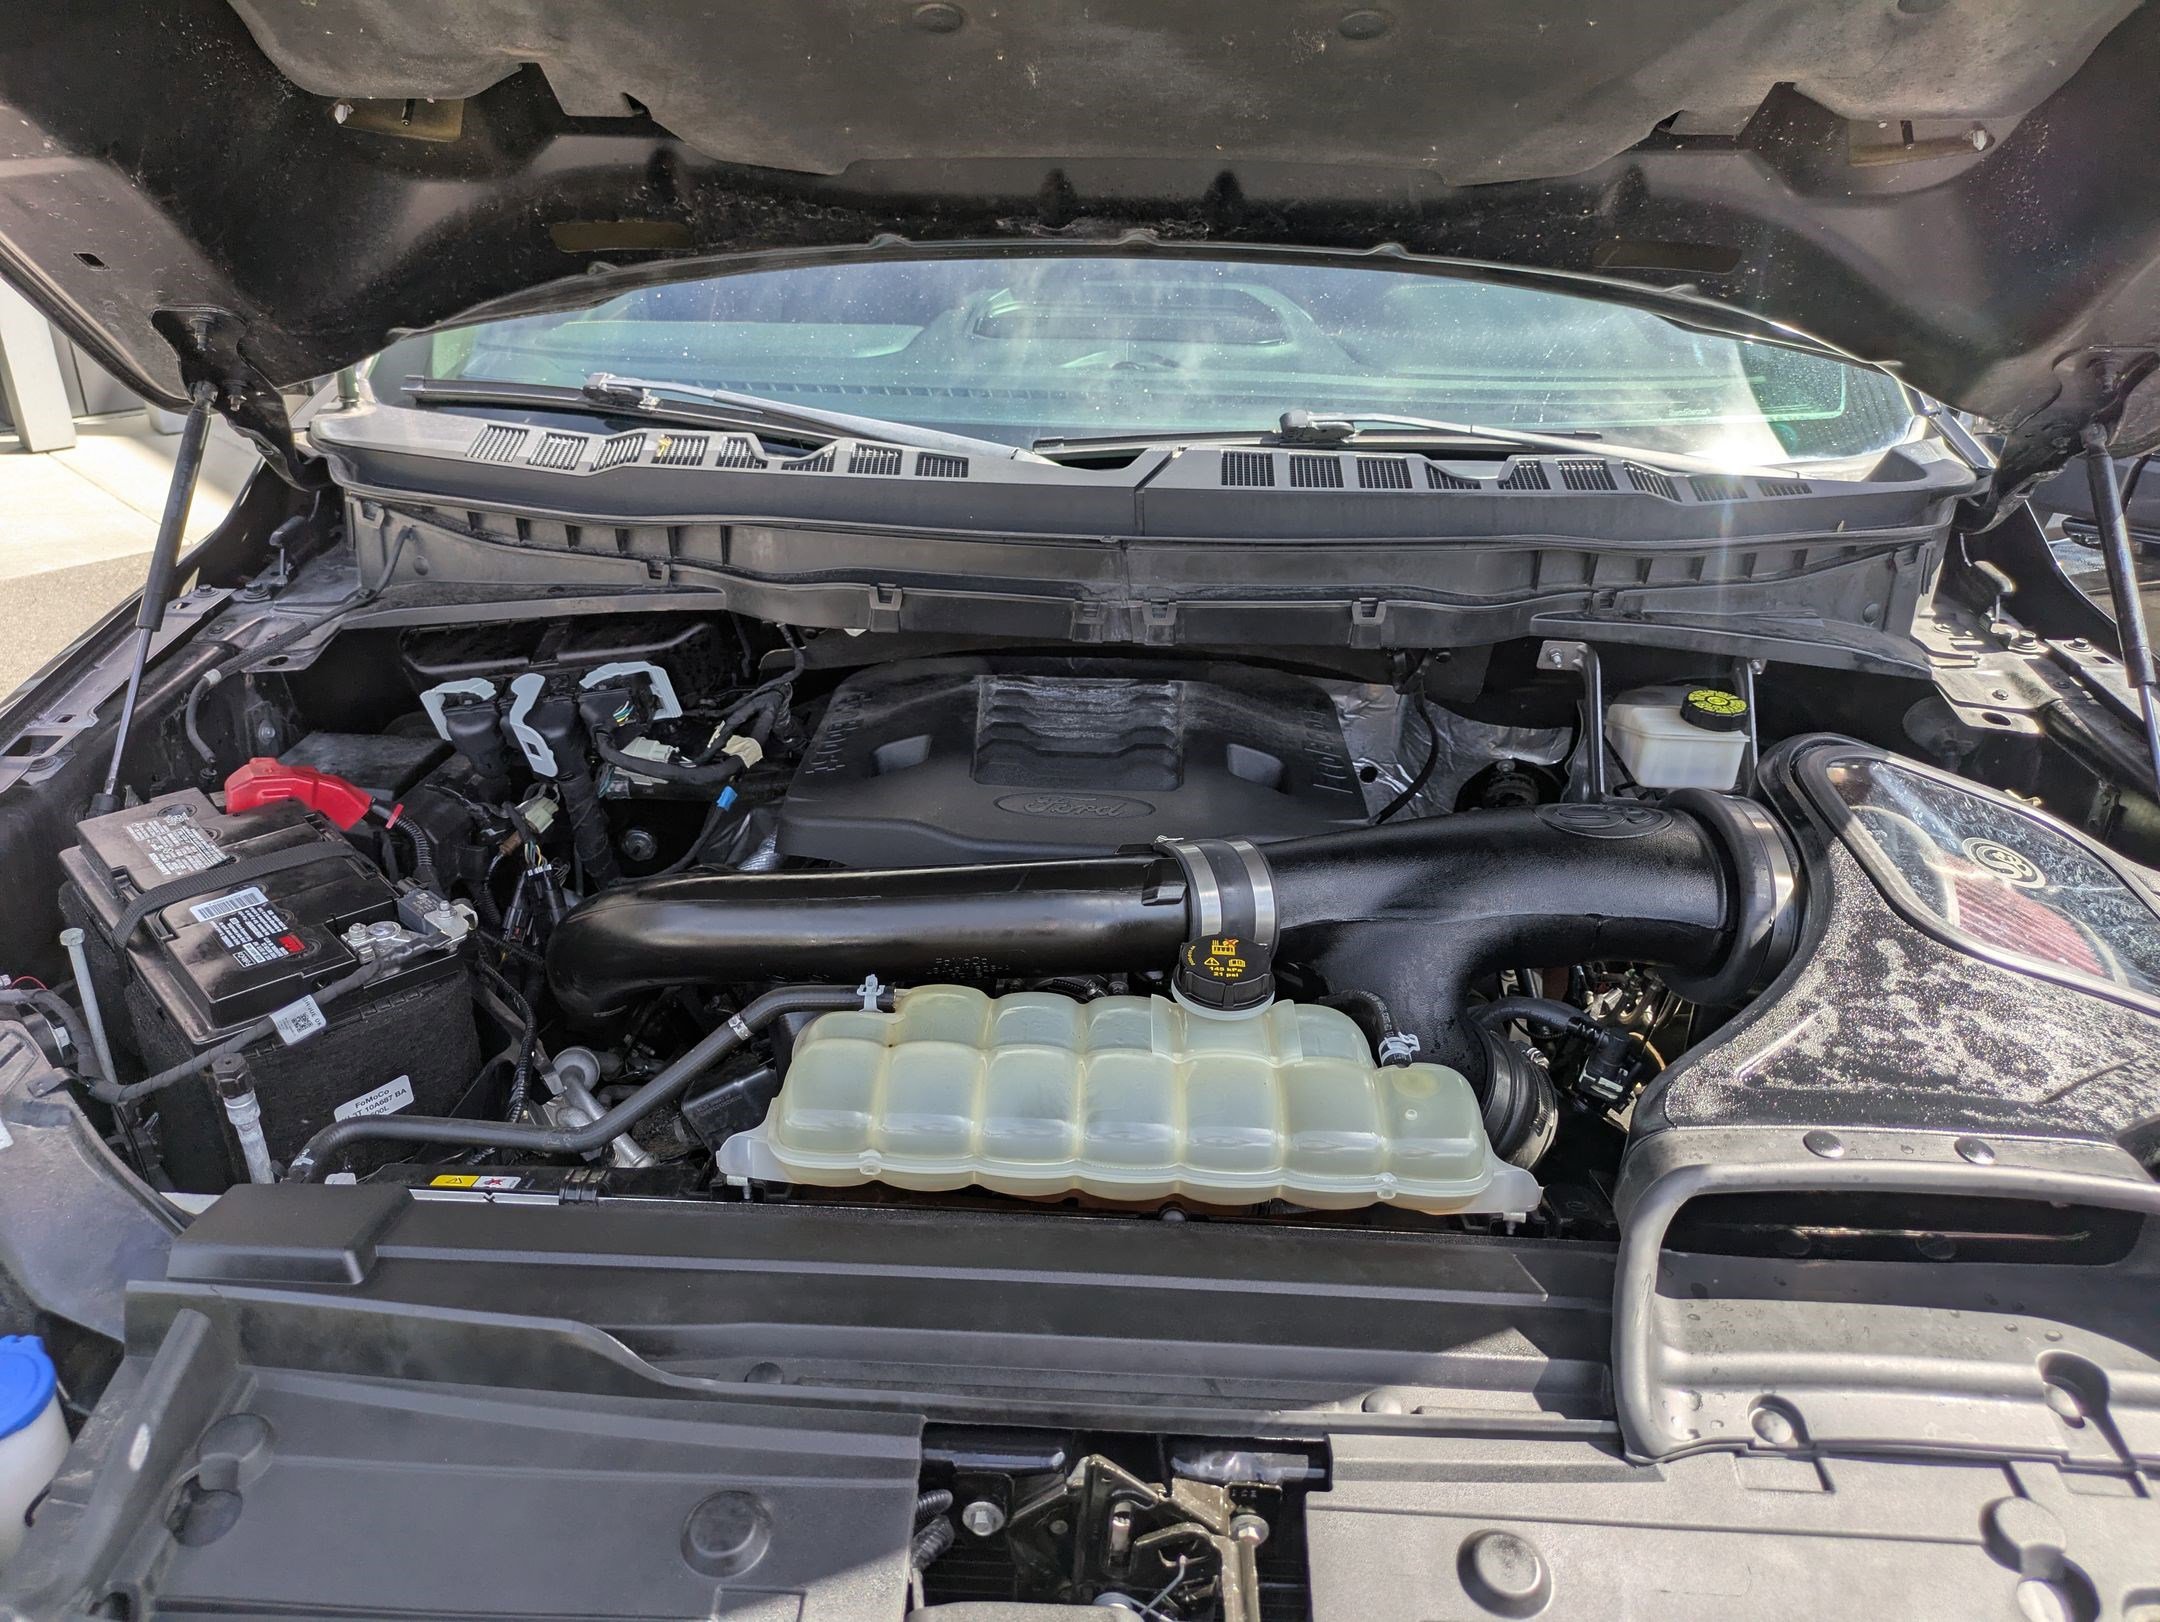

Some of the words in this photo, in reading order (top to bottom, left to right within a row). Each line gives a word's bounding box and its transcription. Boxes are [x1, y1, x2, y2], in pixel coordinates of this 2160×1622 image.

[1024, 795, 1123, 817] Ford
[355, 1089, 390, 1109] FoMoCo
[365, 1094, 393, 1113] 10A687
[394, 1088, 407, 1098] BA
